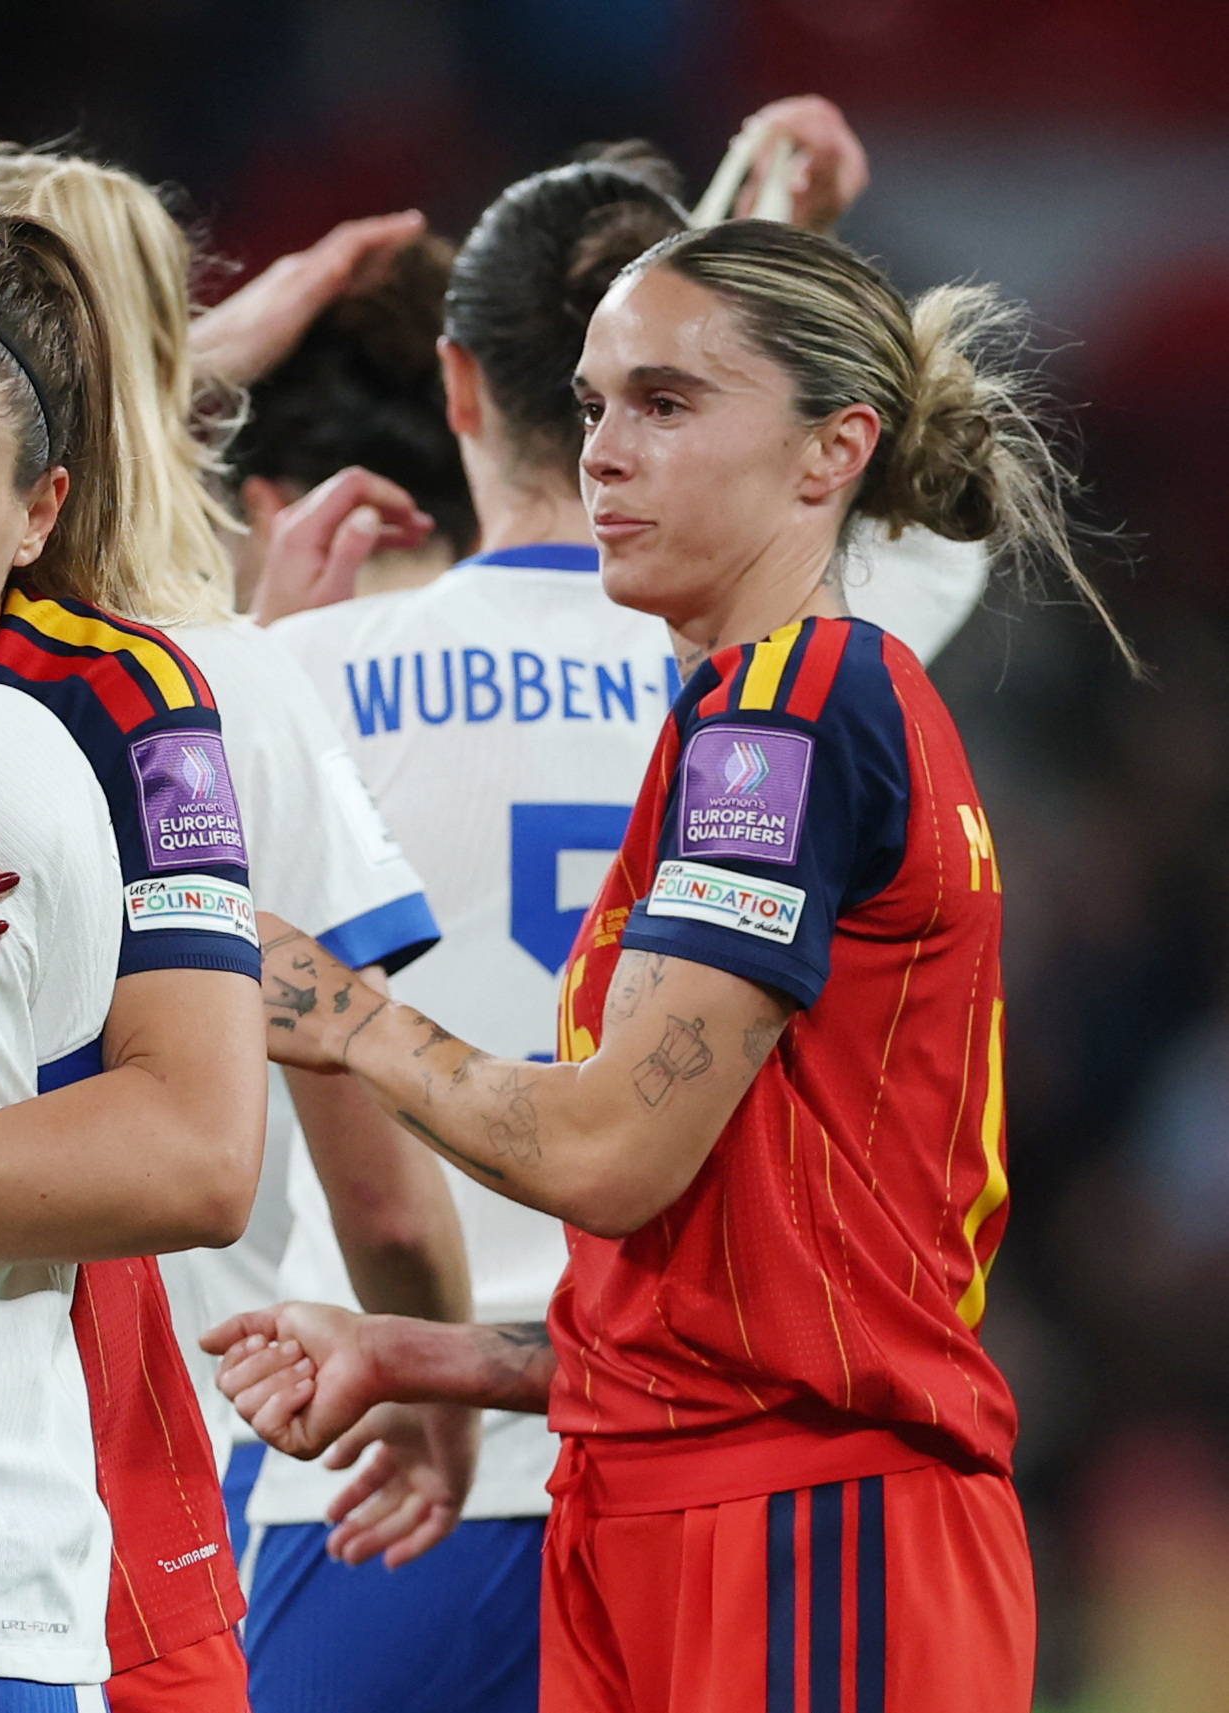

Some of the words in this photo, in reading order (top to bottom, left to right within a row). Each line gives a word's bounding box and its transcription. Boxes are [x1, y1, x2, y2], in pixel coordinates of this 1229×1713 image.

[159, 814, 240, 833] EUROPEAN
[689, 809, 786, 829] EUROPEAN
[159, 830, 242, 851] QUALIFIERS
[686, 825, 786, 846] QUALIFIERS
[130, 882, 166, 896] UEFA
[737, 914, 752, 928] for
[754, 918, 790, 938] children
